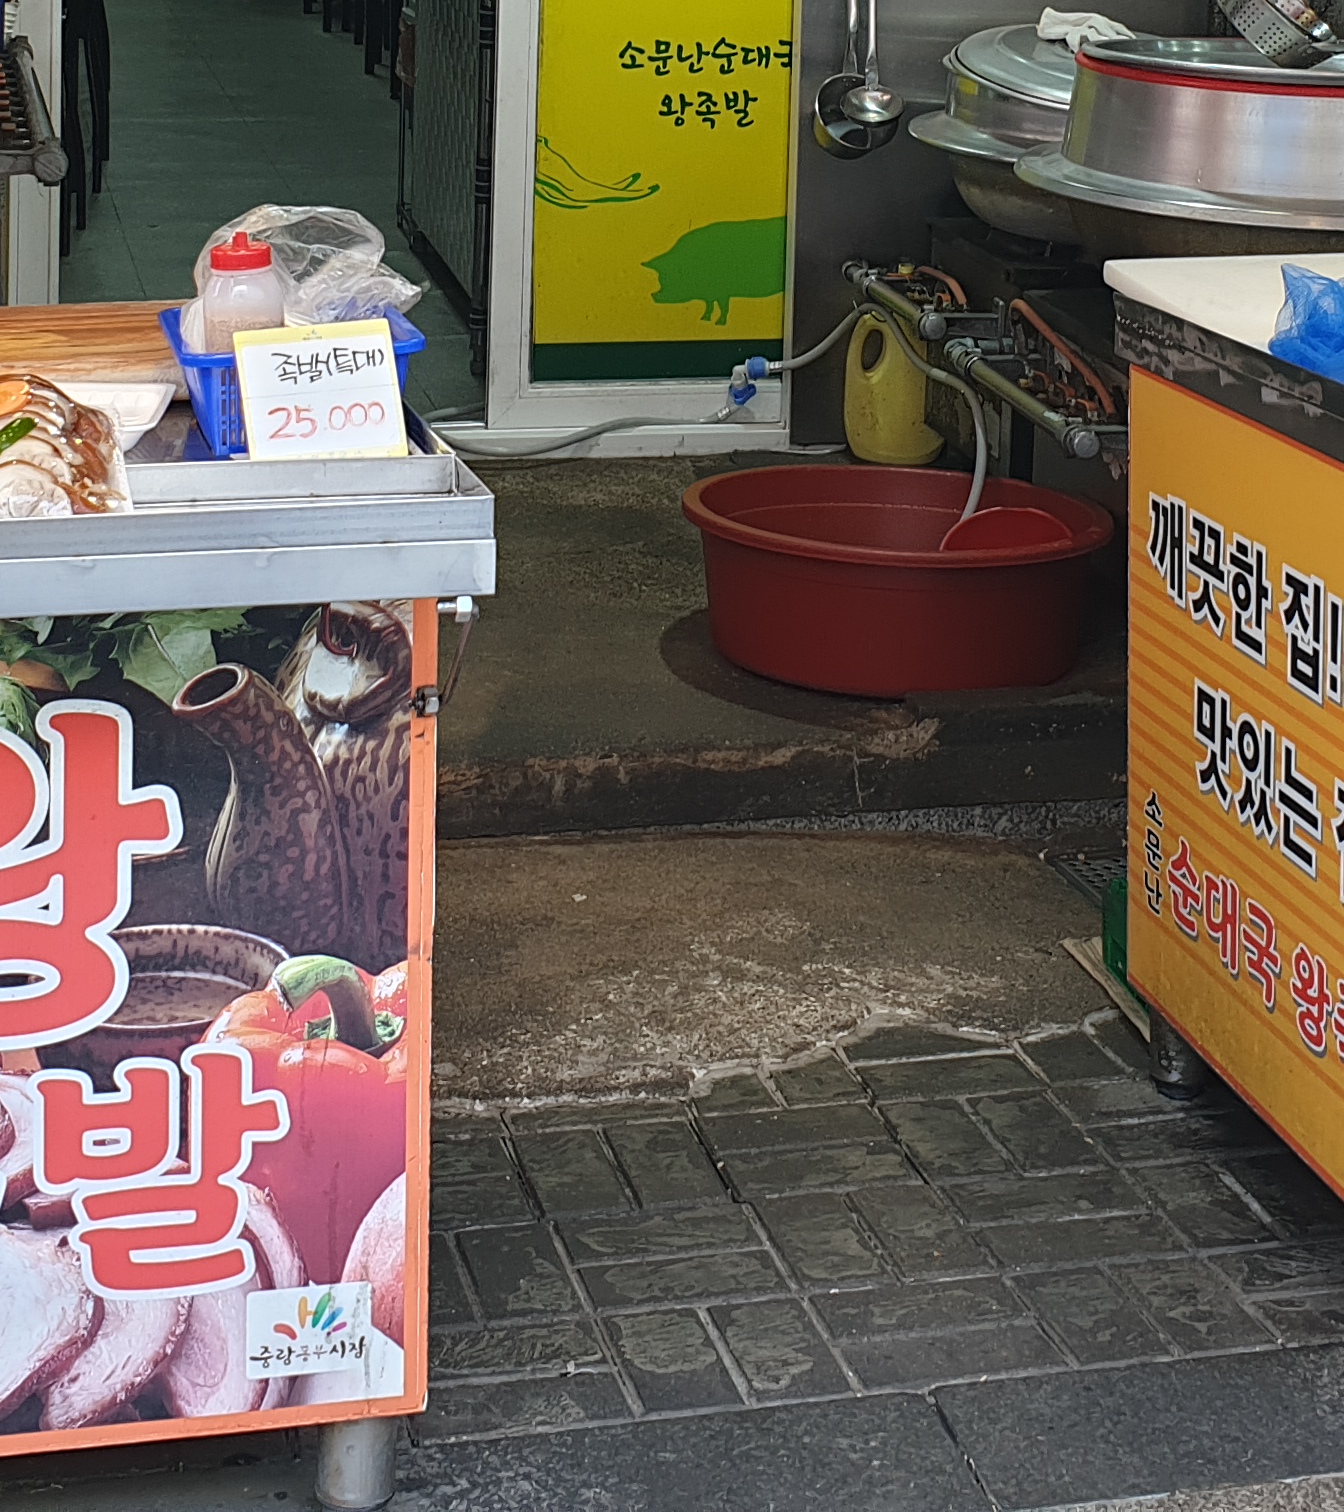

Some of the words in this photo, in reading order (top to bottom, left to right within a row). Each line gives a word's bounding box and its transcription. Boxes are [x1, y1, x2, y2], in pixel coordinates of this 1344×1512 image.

[658, 88, 759, 130] 왕족발
[1148, 492, 1270, 666] 깨끗한
[1194, 678, 1321, 880] 맛있는
[1167, 838, 1283, 1010] 순대국
